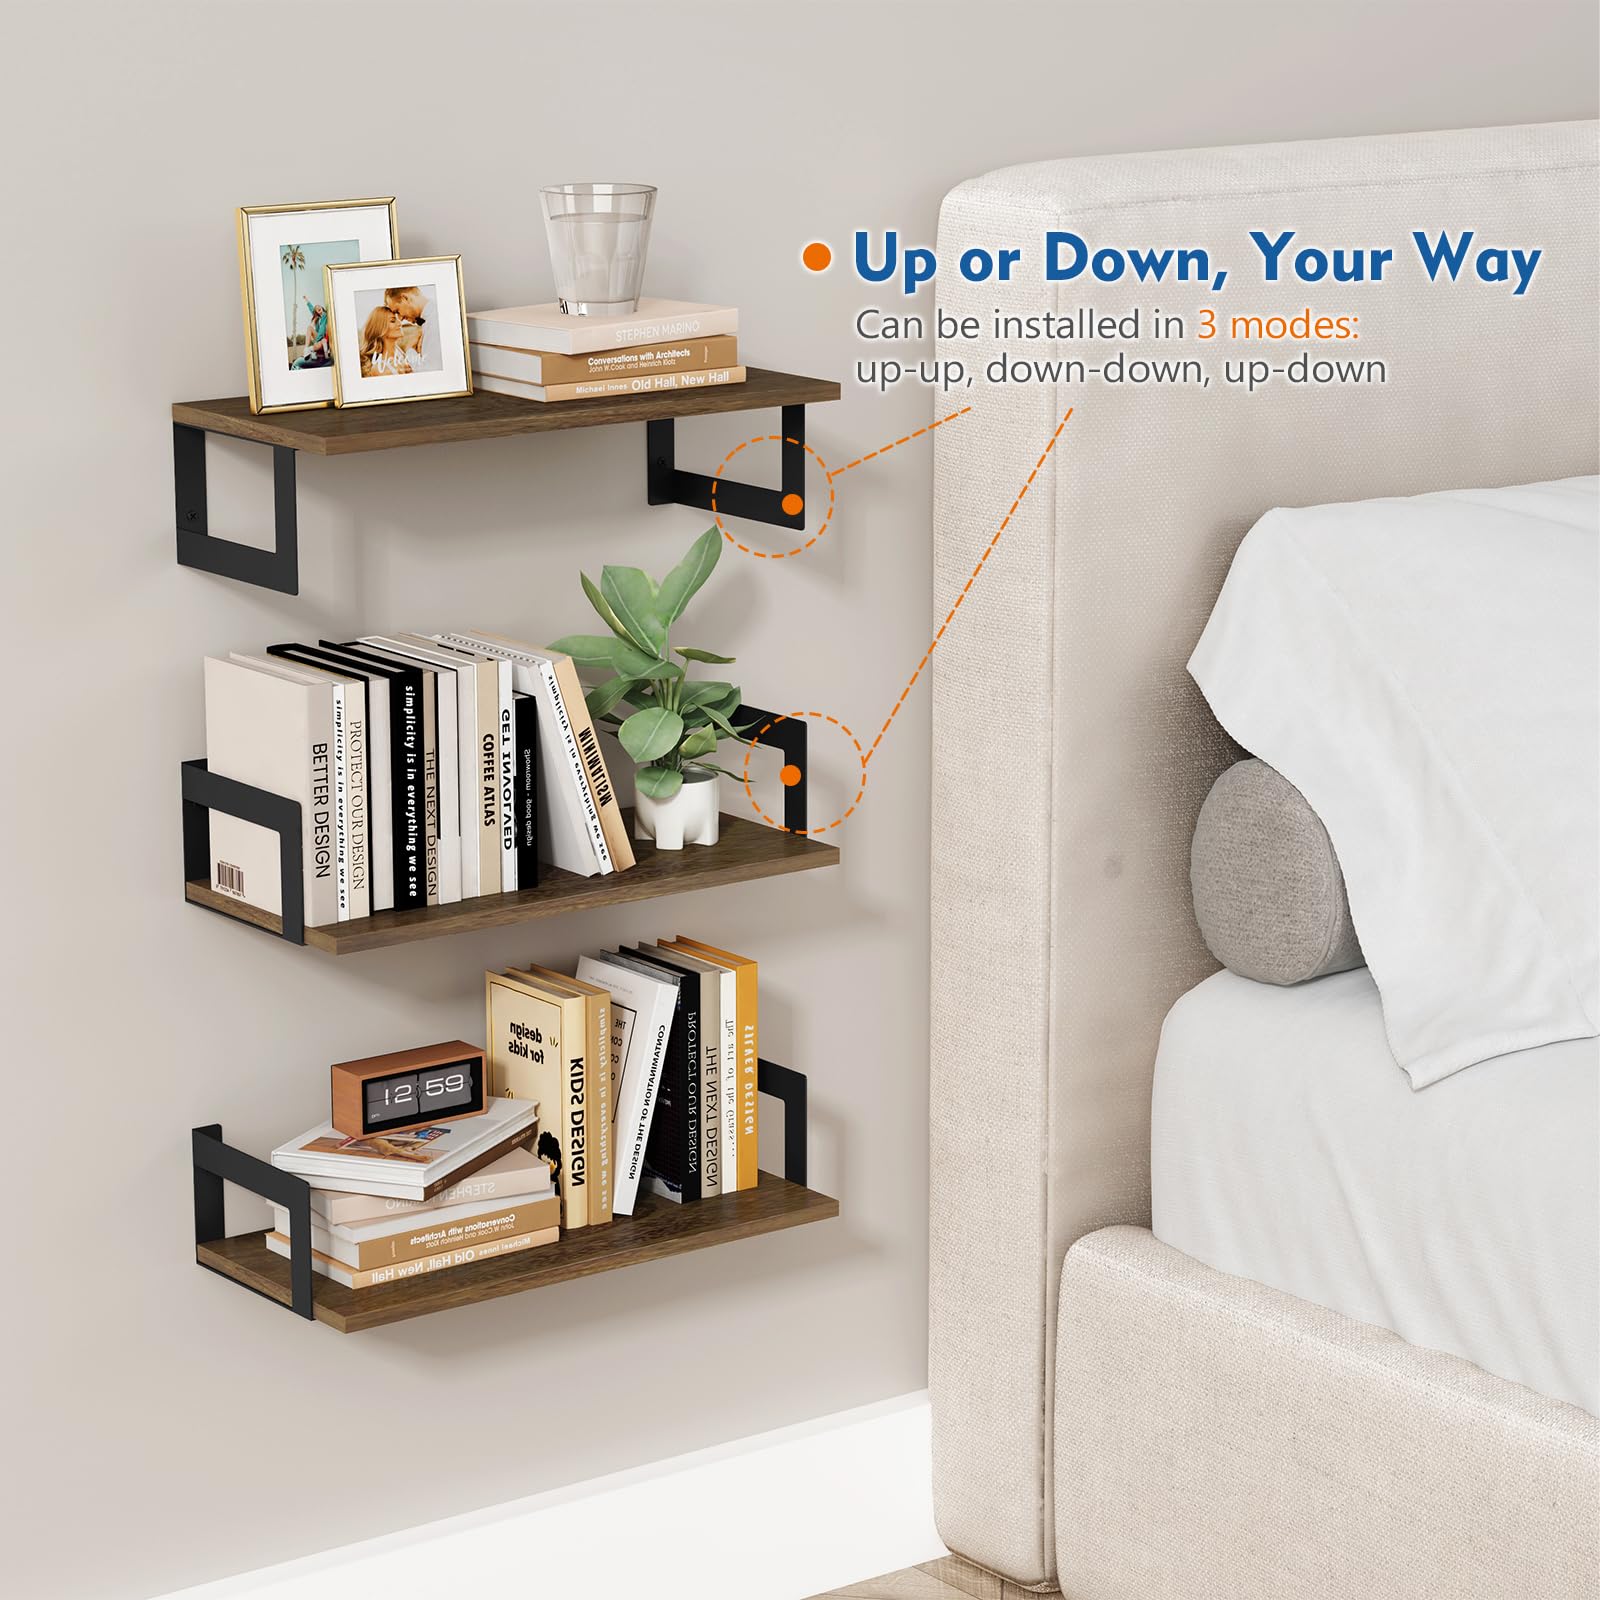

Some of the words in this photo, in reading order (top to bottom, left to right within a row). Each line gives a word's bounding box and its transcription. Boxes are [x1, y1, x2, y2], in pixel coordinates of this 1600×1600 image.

[616, 324, 660, 343] STEPHEN
[661, 319, 700, 337] MARINO
[588, 353, 638, 366] Conversations
[639, 351, 655, 361] with
[656, 348, 691, 360] Architects
[626, 361, 638, 369] and
[640, 360, 662, 368] Heinrich
[576, 384, 606, 394] Michael
[607, 383, 628, 392] Innes
[631, 377, 651, 391] Old
[655, 376, 678, 391] Hall,
[681, 373, 705, 386] New
[708, 370, 730, 383] Hall
[335, 699, 343, 761] simplicity
[403, 685, 416, 749] simplicity
[337, 766, 344, 776] is
[349, 720, 363, 791] PROTECT
[406, 752, 415, 763] is
[425, 748, 435, 781] THE
[482, 733, 495, 782] COFFEE
[312, 742, 329, 806] BETTER
[338, 781, 344, 793] in
[406, 767, 416, 780] in
[351, 794, 364, 831] OUR
[405, 784, 418, 852] everything
[426, 785, 436, 828] NEXT
[483, 786, 496, 827] ATLAS
[314, 812, 331, 878] DESIGN
[351, 833, 365, 890] DESIGN
[339, 868, 345, 884] we
[407, 855, 417, 872] we
[426, 834, 437, 897] DESIGN
[408, 875, 417, 897] see
[384, 1084, 413, 1106] 12
[425, 1074, 464, 1097] 59
